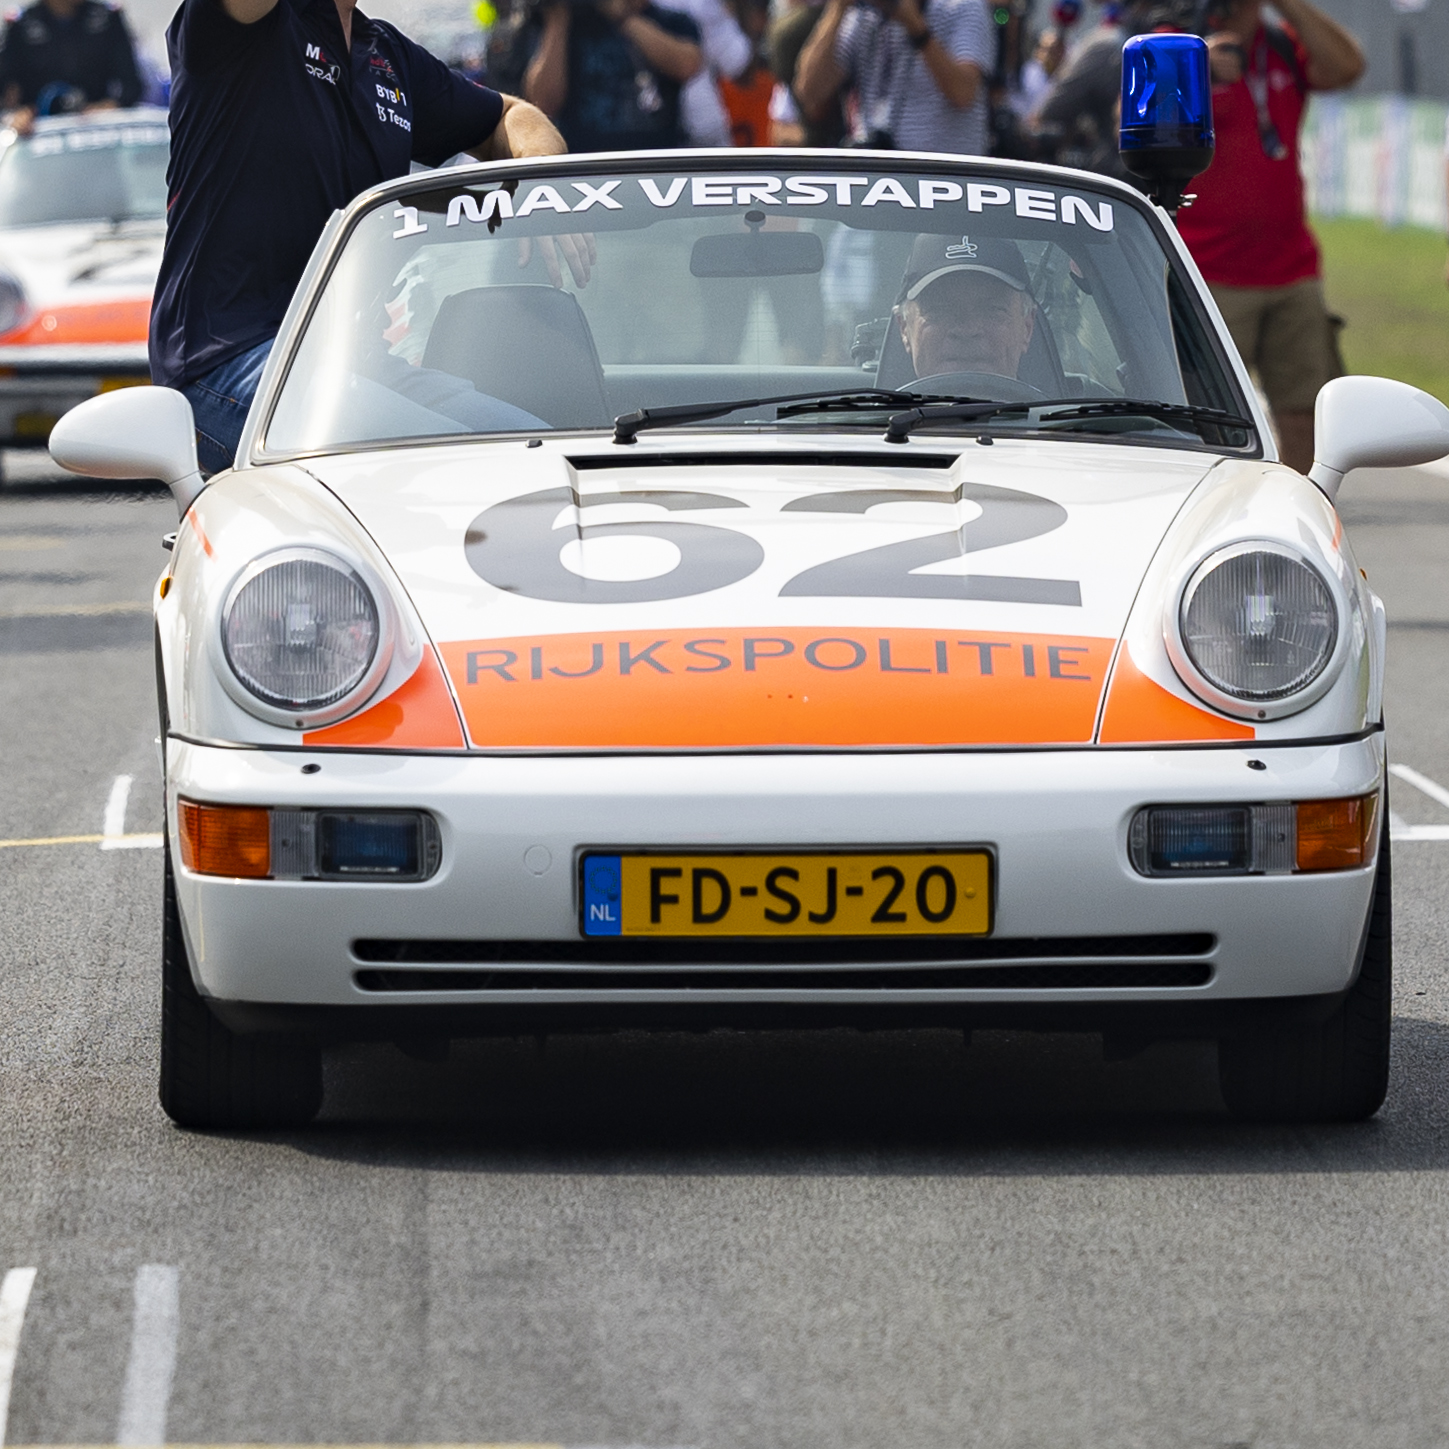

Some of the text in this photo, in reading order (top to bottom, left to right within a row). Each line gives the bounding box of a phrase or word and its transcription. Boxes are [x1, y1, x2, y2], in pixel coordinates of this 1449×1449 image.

[392, 175, 1115, 240] 1 MAX VERSTAPPEN
[464, 481, 1083, 605] 62
[466, 636, 1092, 685] RIJKSPOLITIE
[590, 903, 616, 922] NL
[649, 865, 957, 924] FD-SJ-20
